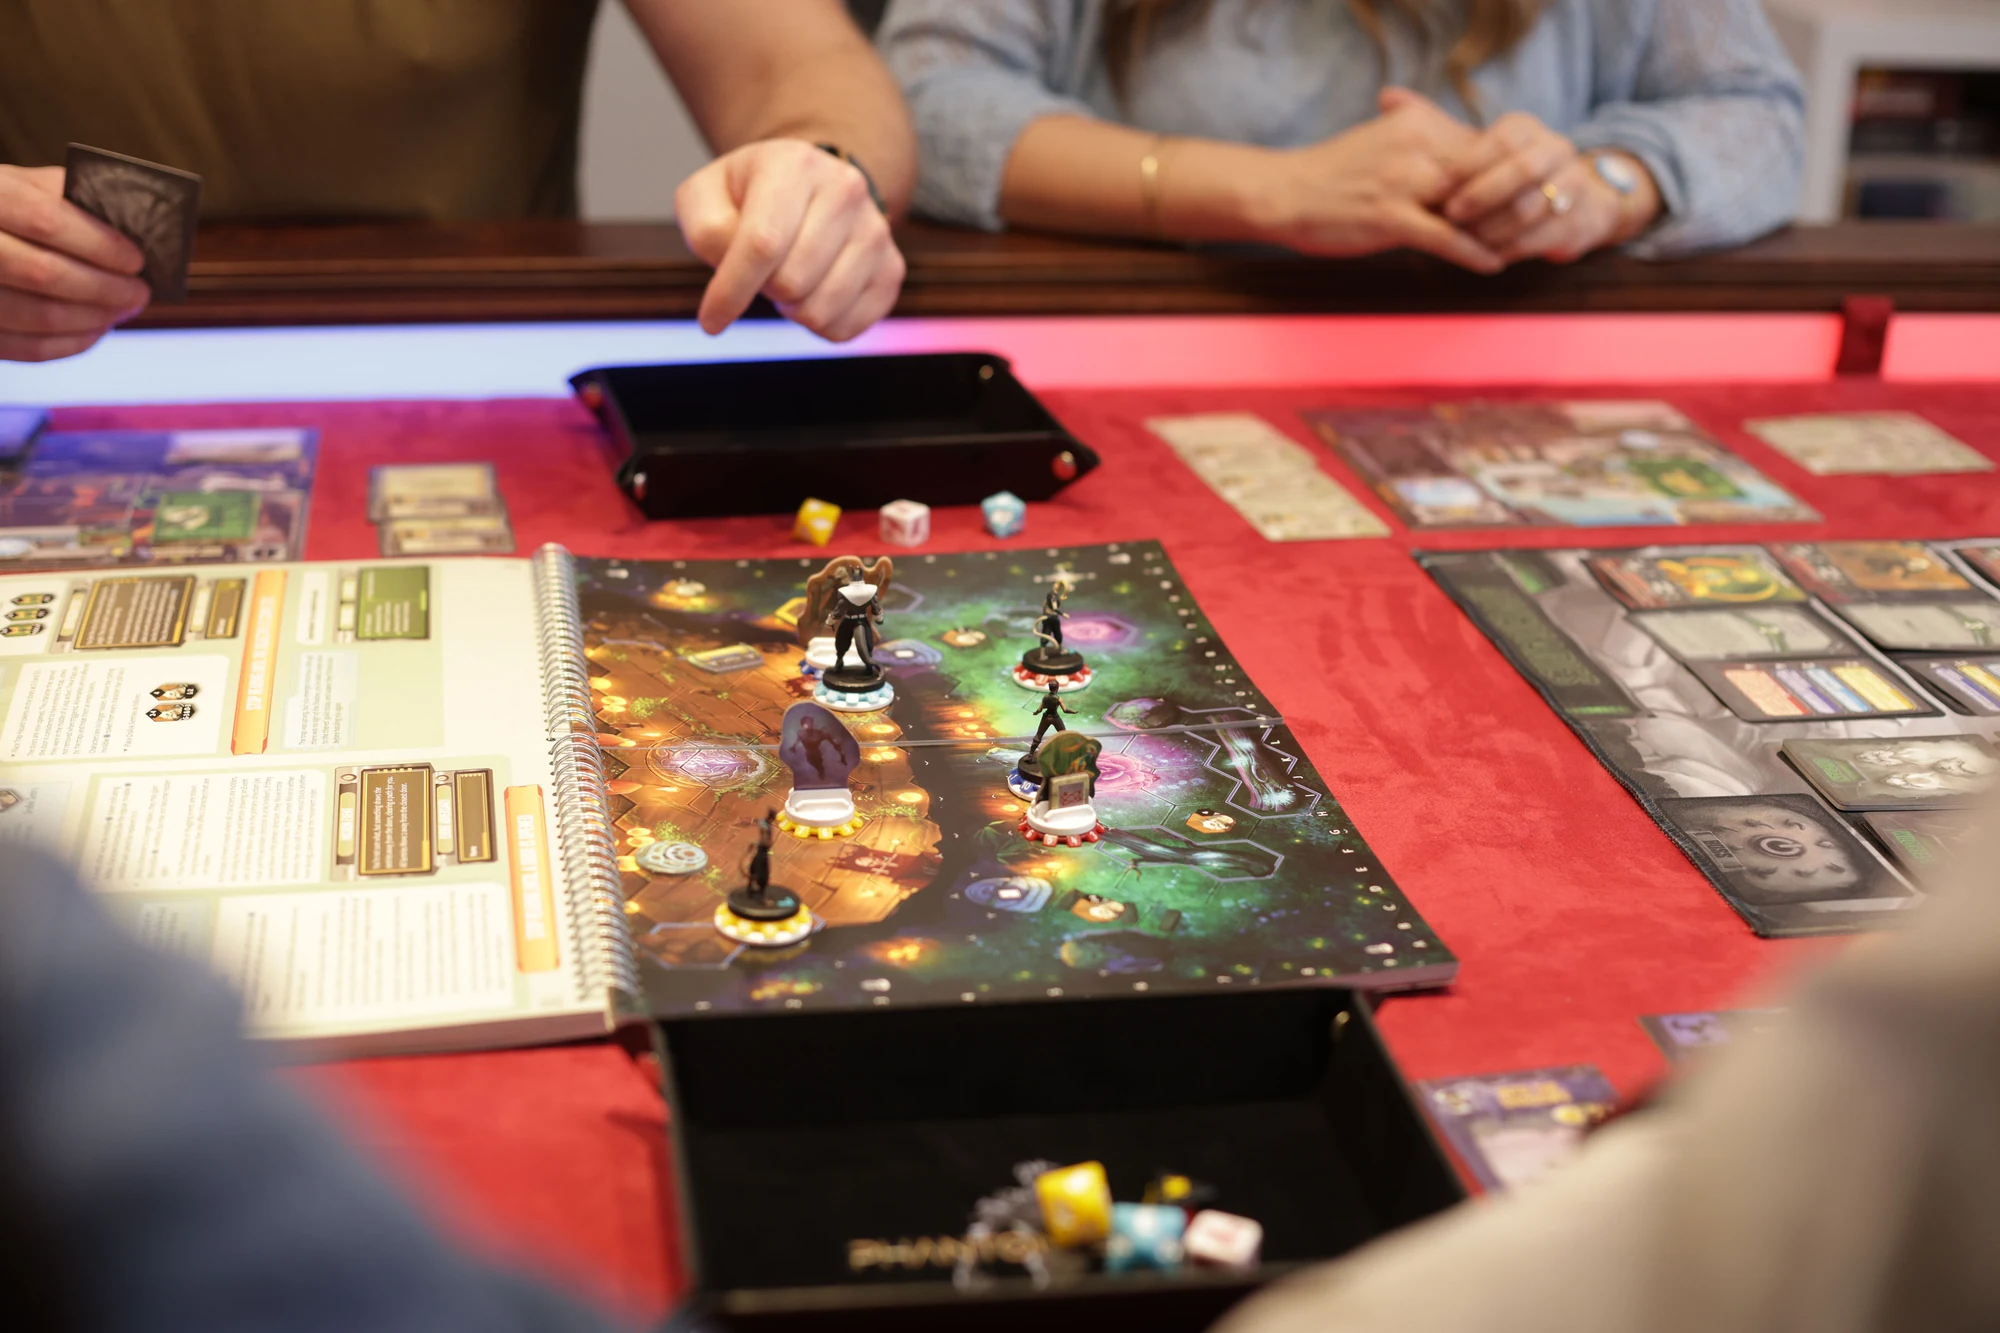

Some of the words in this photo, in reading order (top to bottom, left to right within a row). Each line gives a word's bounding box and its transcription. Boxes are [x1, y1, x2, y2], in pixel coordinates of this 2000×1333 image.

[1021, 781, 1031, 790] 10
[1703, 839, 1734, 859] BOSS
[847, 1235, 1050, 1272] PHANTO
